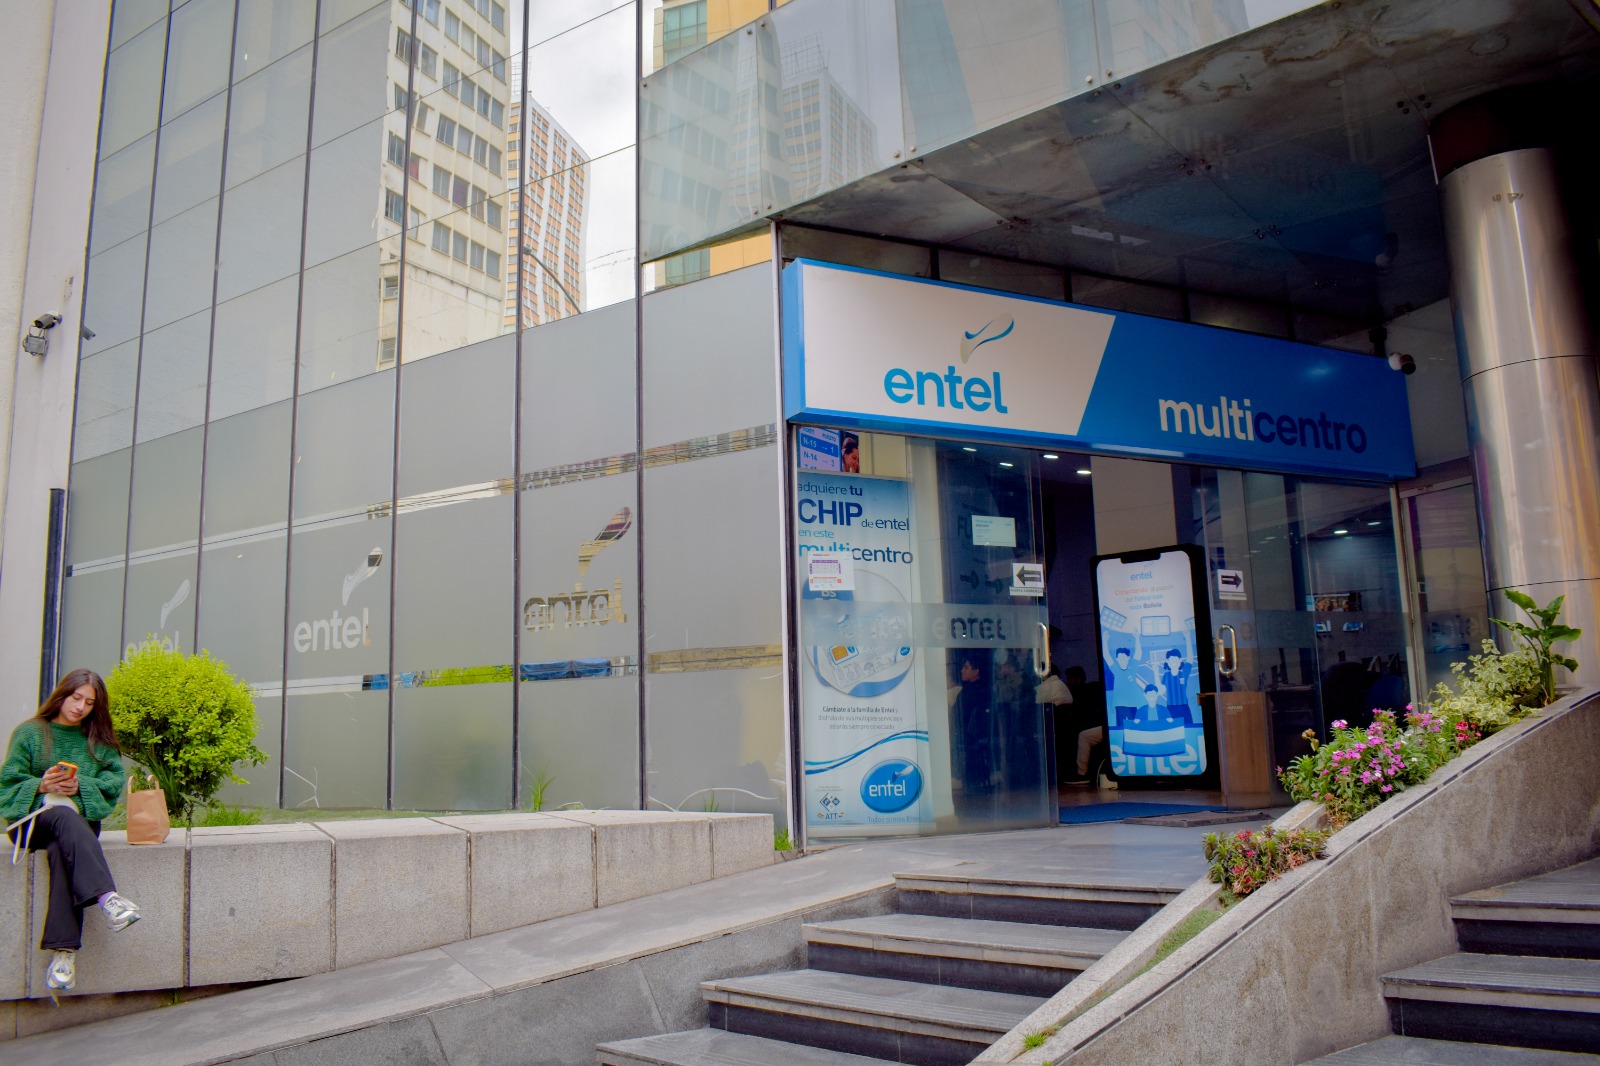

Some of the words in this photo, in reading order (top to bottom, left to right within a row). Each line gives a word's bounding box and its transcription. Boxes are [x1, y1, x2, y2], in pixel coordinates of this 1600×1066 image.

[884, 366, 1008, 414] entel
[1159, 396, 1367, 453] multicentro
[803, 437, 817, 448] N-15
[830, 446, 835, 454] 1
[803, 451, 818, 461] N-14
[798, 482, 847, 495] adquiere
[849, 485, 863, 496] tu
[798, 498, 863, 526] CHIP
[861, 518, 874, 528] de
[875, 518, 910, 530] entel
[799, 529, 811, 537] en
[813, 529, 834, 538] este
[1130, 571, 1152, 580] entel
[524, 577, 628, 632] entel
[294, 608, 372, 652] entel
[868, 780, 906, 797] entel
[825, 812, 837, 820] ATT
